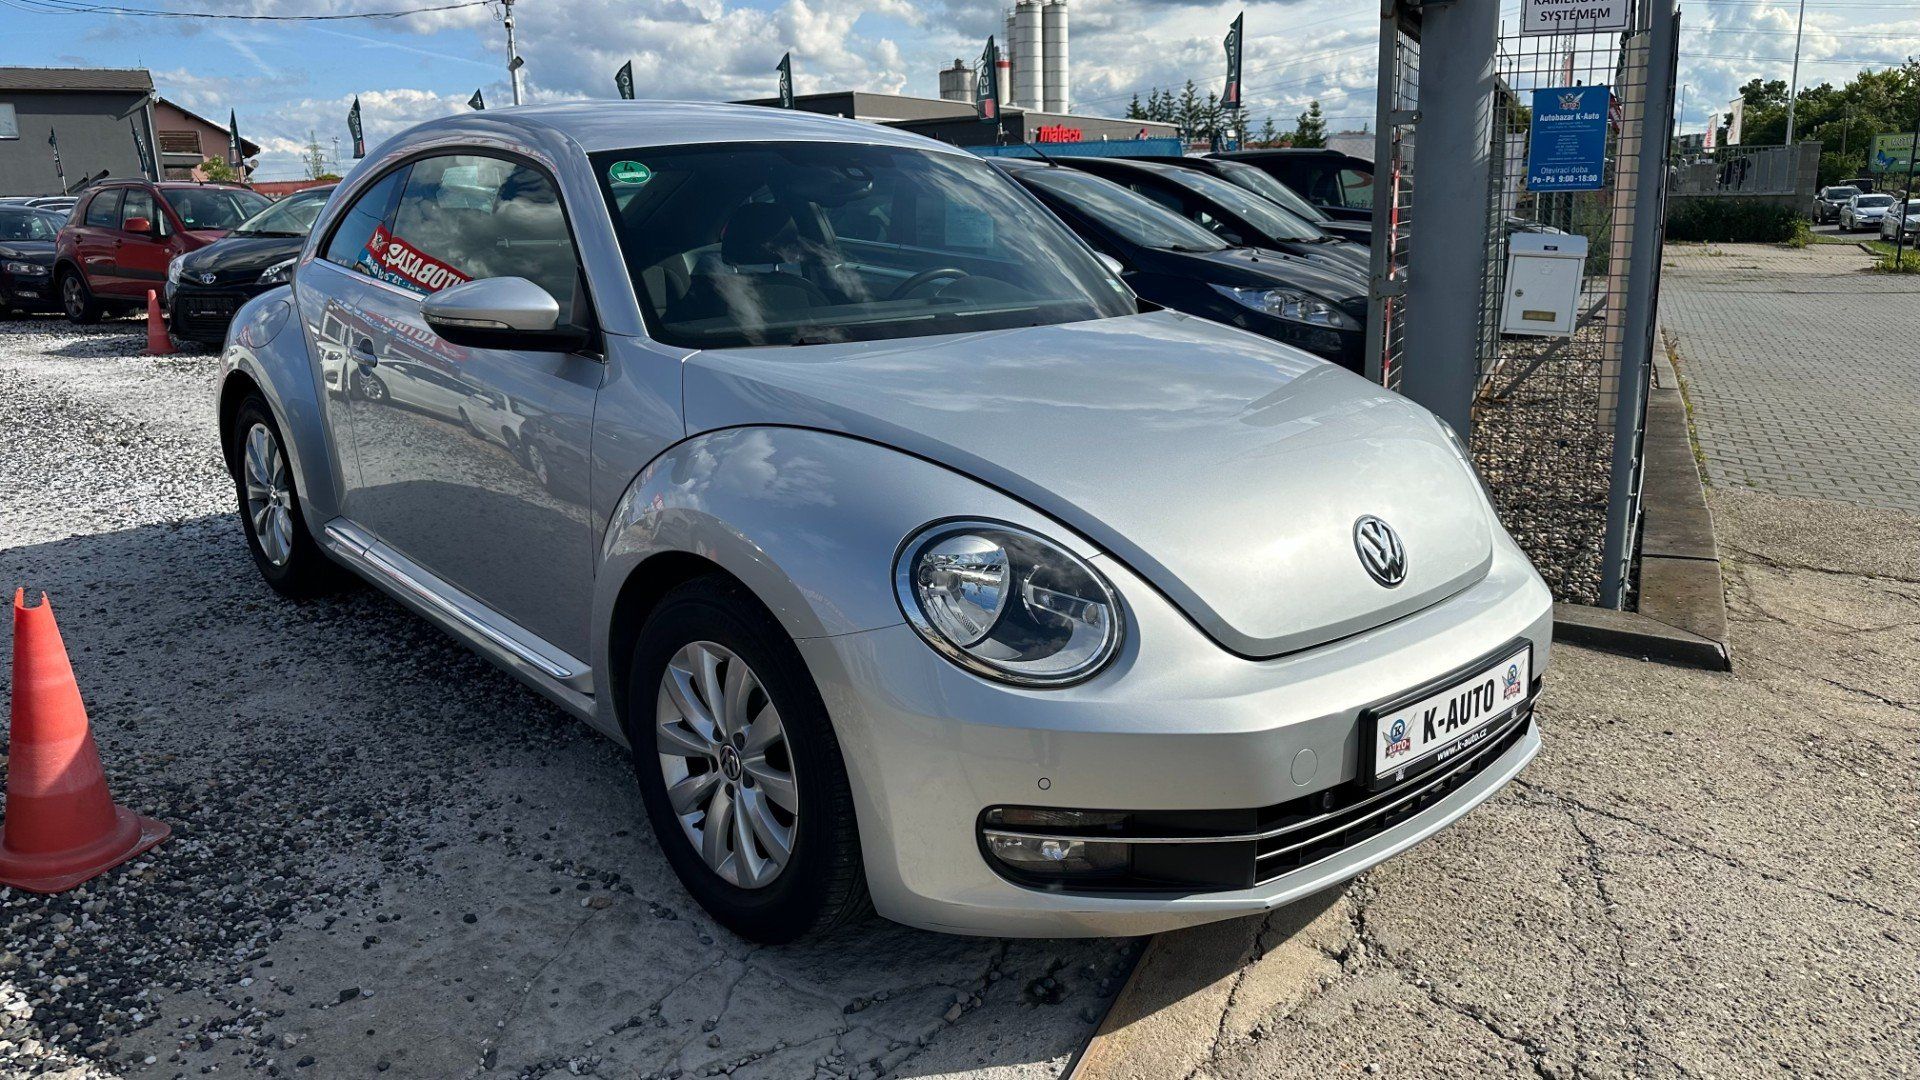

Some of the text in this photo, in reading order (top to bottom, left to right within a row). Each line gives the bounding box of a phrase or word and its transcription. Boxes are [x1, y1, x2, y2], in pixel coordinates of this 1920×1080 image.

[1540, 7, 1611, 22] SYSTÉMEM
[1539, 112, 1600, 122] Autobazar K-Auto
[1040, 124, 1082, 142] mateco
[1571, 165, 1589, 174] doba
[1423, 678, 1495, 744] K-AUTO
[1394, 725, 1402, 737] K
[1389, 740, 1407, 753] AUTO
[1437, 728, 1488, 761] www.k-auto.cz
